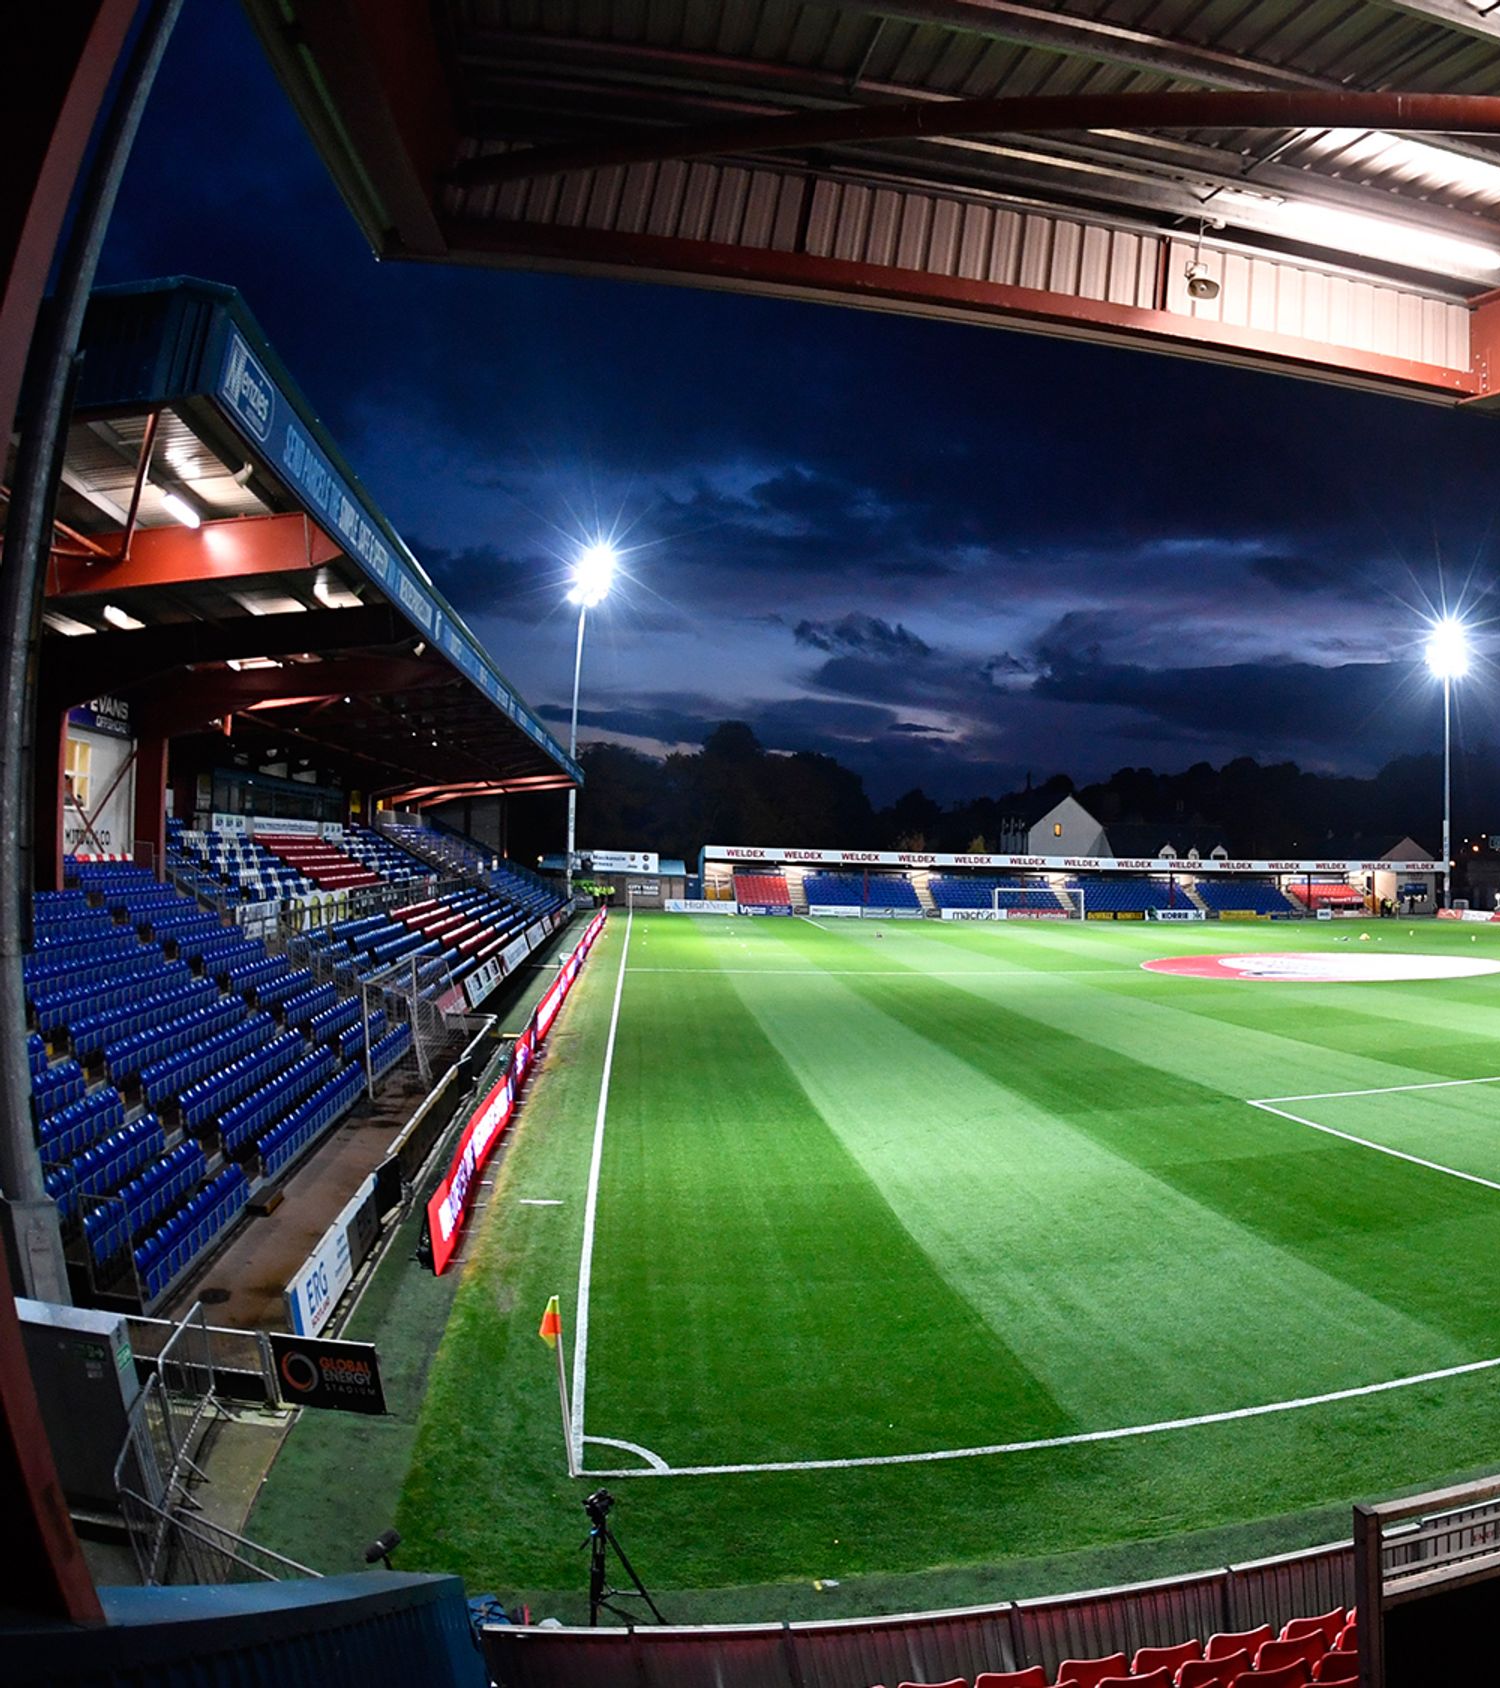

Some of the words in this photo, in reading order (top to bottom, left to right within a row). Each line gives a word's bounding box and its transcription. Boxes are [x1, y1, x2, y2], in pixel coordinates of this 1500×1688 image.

[226, 350, 269, 422] Menzies
[90, 696, 129, 720] EVANS
[726, 849, 765, 858] WELDEX
[784, 851, 823, 860] WELDEX
[842, 852, 880, 862] WELDEX
[898, 854, 936, 863] WELDEX
[954, 856, 992, 864] WELDEX
[1010, 857, 1047, 865] WELDEX
[1064, 859, 1100, 867] WELDEX
[1117, 860, 1152, 868] WELDEX
[1169, 861, 1203, 869] WELDEX
[1219, 862, 1252, 870] WELDEX
[305, 1260, 328, 1317] ERG
[319, 1355, 370, 1372] GLOBAL
[323, 1369, 372, 1386] ENERGY
[324, 1382, 376, 1397] STADIUM
